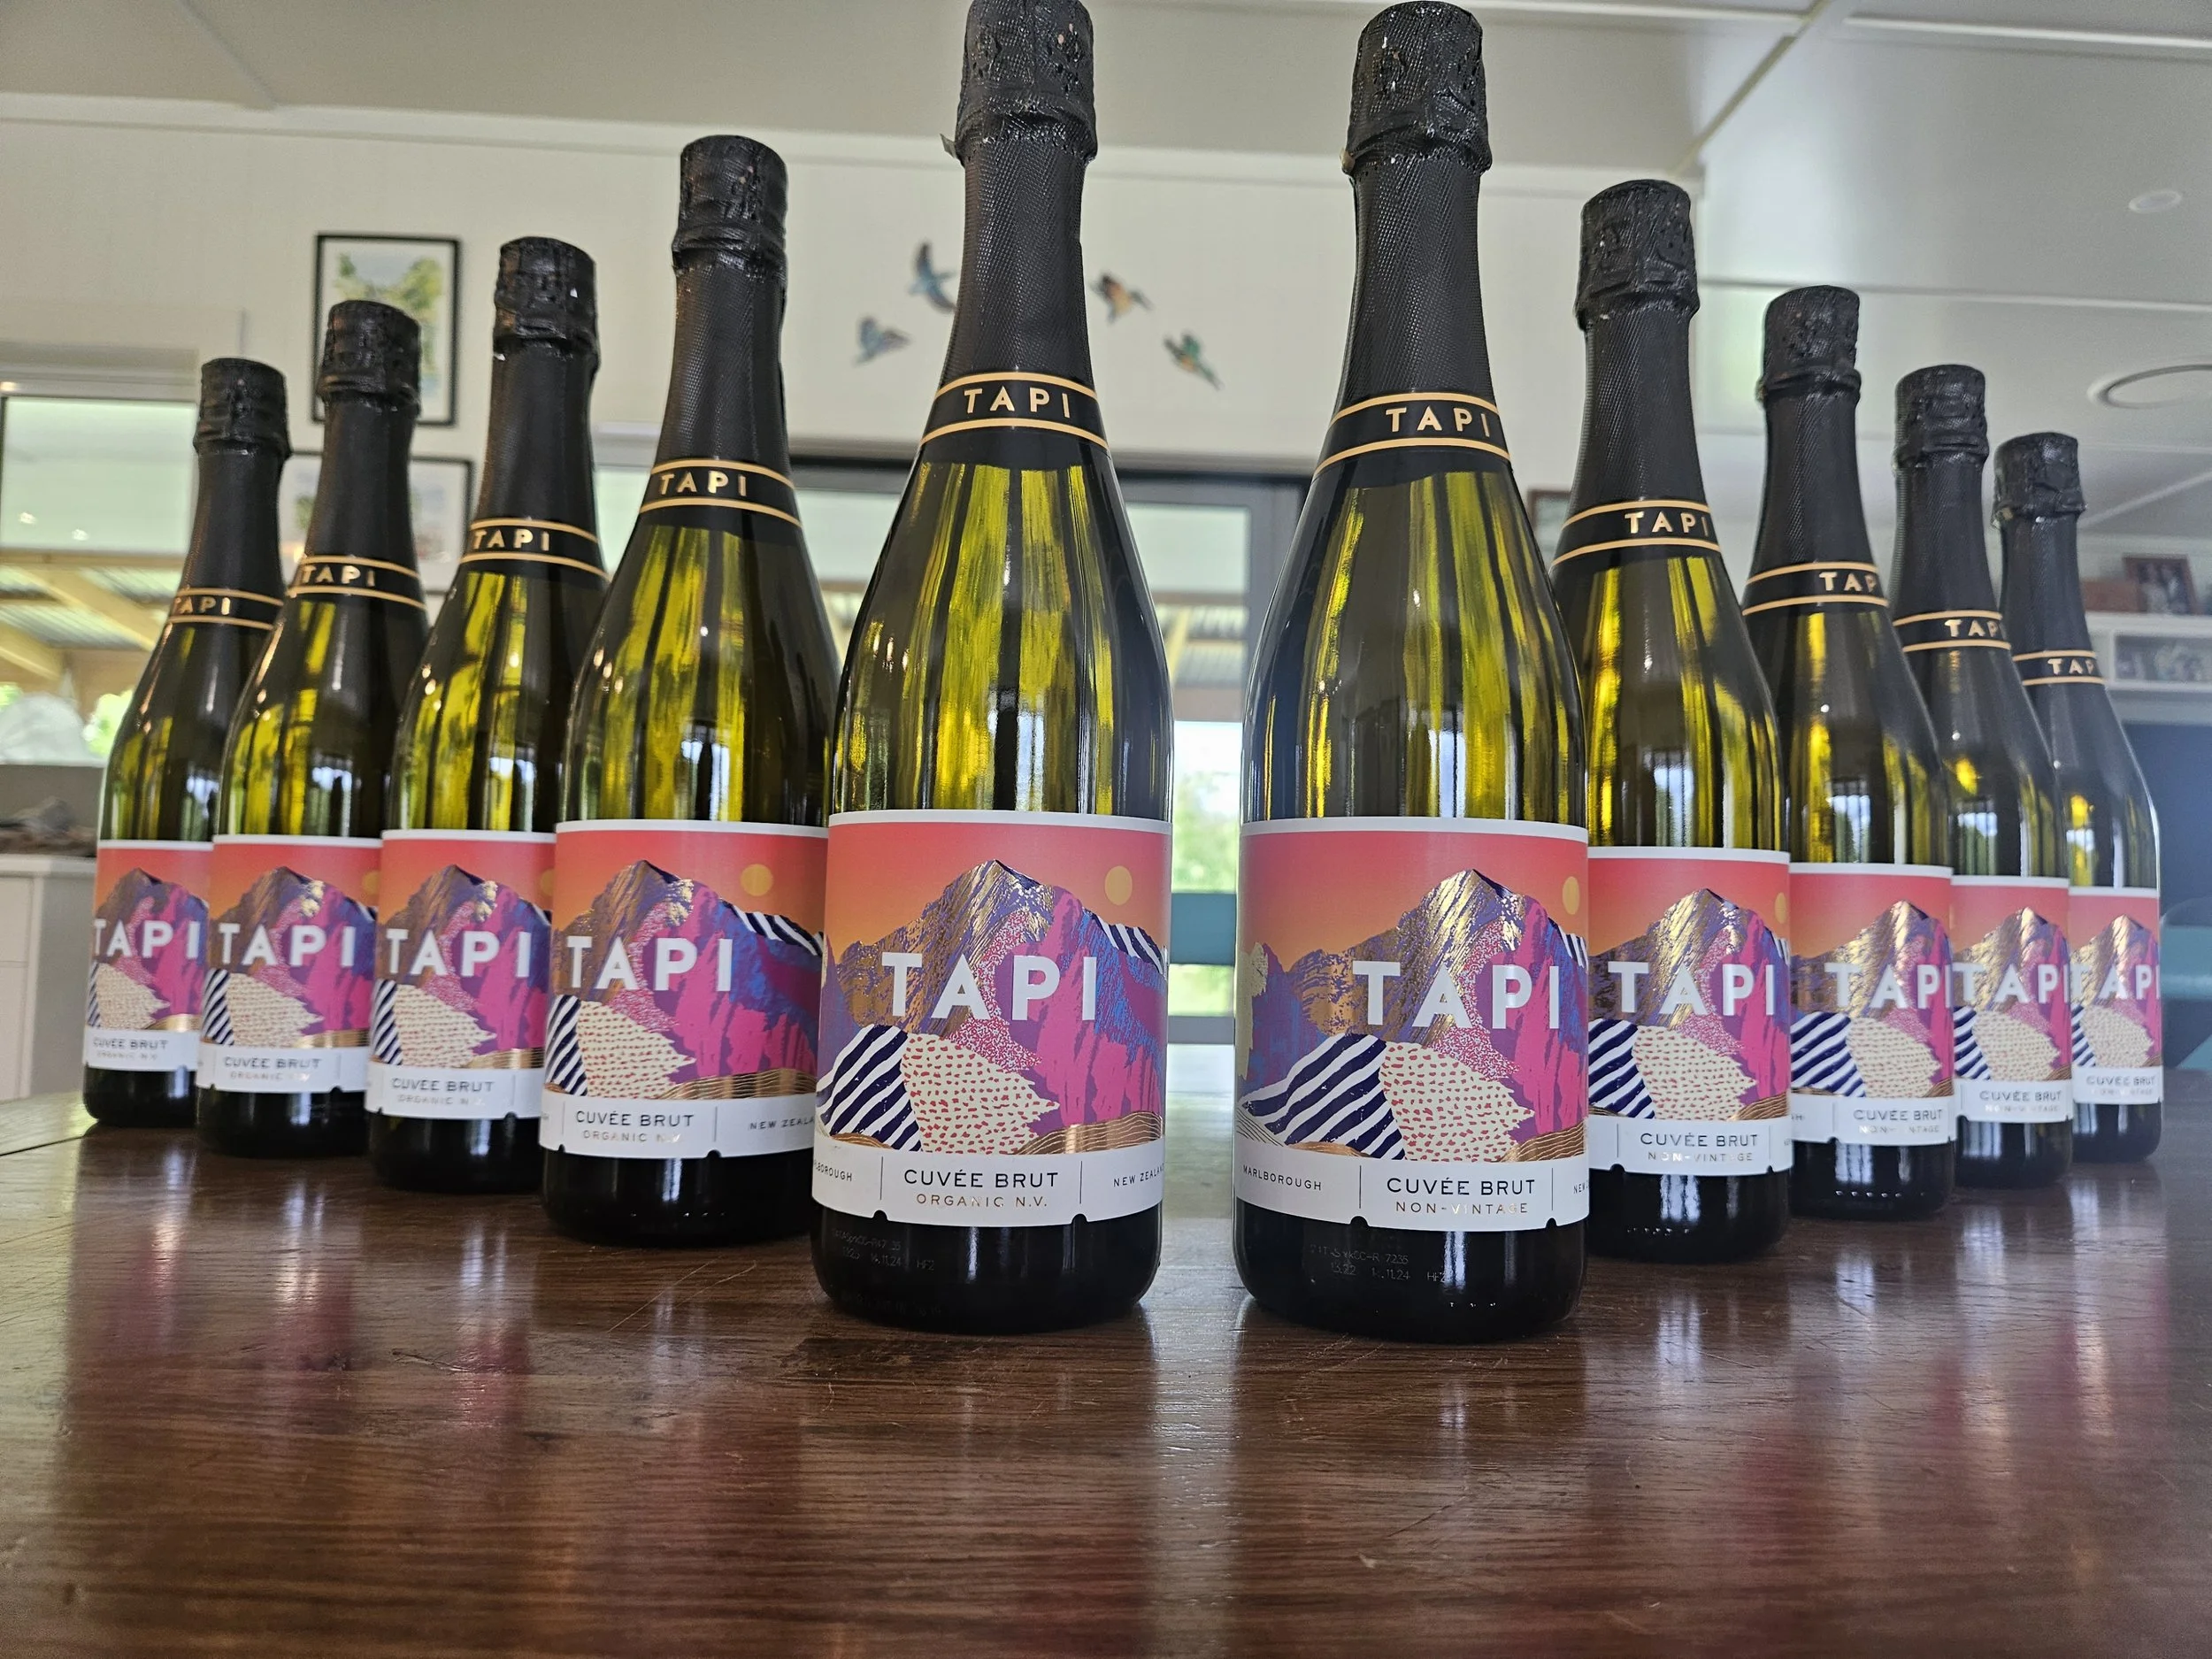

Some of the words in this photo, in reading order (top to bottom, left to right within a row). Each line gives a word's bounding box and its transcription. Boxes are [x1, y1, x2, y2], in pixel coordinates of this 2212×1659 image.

[963, 386, 1070, 419] TAPI
[1385, 407, 1491, 436] TAPI
[658, 469, 749, 497] TAPI
[1624, 511, 1709, 537] TAPI
[472, 528, 549, 551] TAPI
[303, 565, 375, 587] TAPI
[94, 918, 200, 959] TAPI
[218, 923, 354, 967] TAPI
[386, 927, 531, 978] TAPI
[566, 935, 733, 992] TAPI
[881, 951, 1097, 1021] TAPI
[1608, 961, 1774, 1016] TAPI
[1824, 962, 1952, 1009] TAPI
[1952, 962, 2070, 1004] TAPI
[1352, 960, 1559, 1029] TAPI
[130, 1039, 168, 1050] BRUT
[275, 1058, 322, 1070] BRUT
[447, 1080, 495, 1093] BRUT
[2133, 1074, 2156, 1087] BRUT
[2035, 1090, 2062, 1102] BRUT
[576, 1110, 632, 1125] CUVÉE
[640, 1114, 695, 1127] BRUT
[749, 1120, 777, 1131] NEW
[1913, 1109, 1943, 1121] BRUT
[583, 1130, 647, 1142] ORGANIC
[1640, 1132, 1708, 1147] CUVÉE
[1716, 1133, 1758, 1147] BRUT
[903, 1169, 983, 1188] CUVÉE
[995, 1171, 1058, 1188] BRUT
[1113, 1174, 1136, 1187] NEW
[1242, 1164, 1322, 1191] MARLBOROUGH
[1386, 1177, 1471, 1195] CUVÉE
[1480, 1179, 1535, 1195] BRUT
[917, 1194, 1004, 1208] ORGANIC
[1015, 1196, 1047, 1208] N.V.
[1395, 1201, 1528, 1215] NON-VINTAGE
